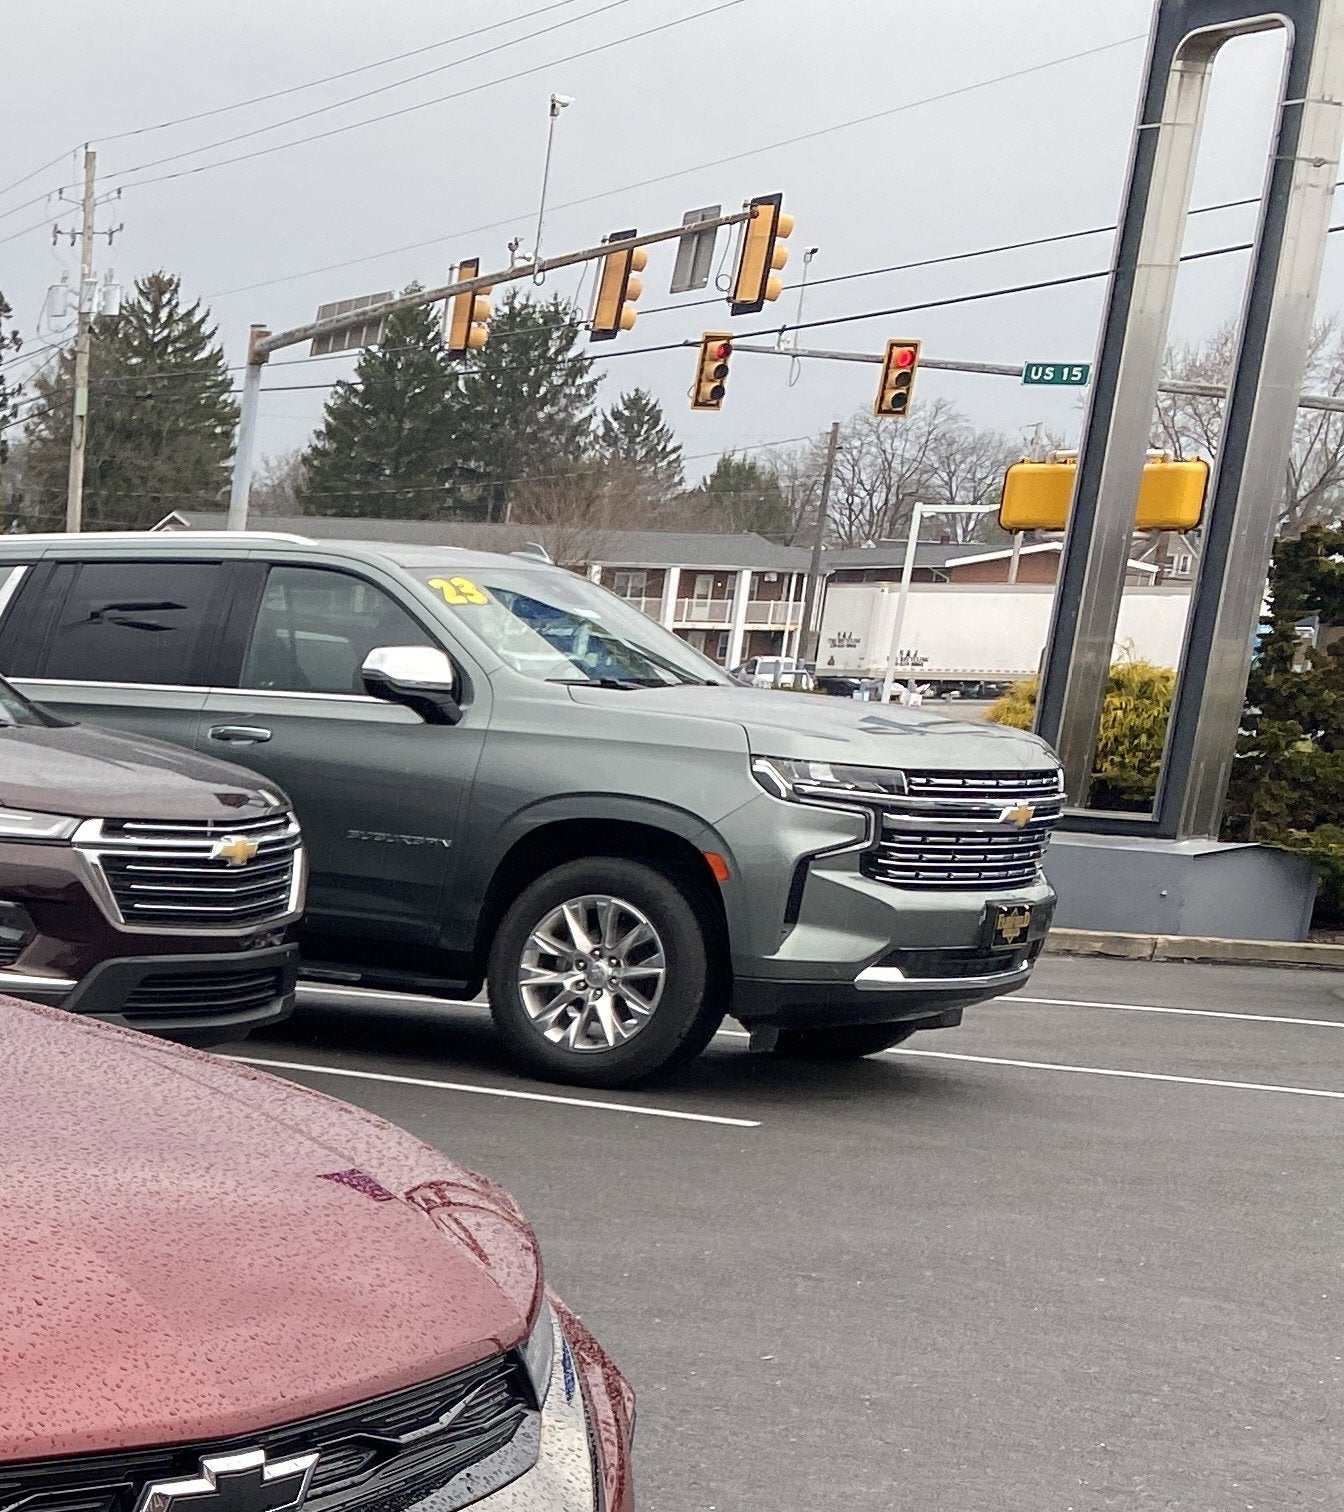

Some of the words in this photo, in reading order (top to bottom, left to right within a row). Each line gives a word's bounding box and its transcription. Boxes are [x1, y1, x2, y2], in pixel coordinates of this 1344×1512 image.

[1031, 366, 1055, 380] US
[1062, 367, 1083, 380] 15
[427, 576, 489, 605] 23
